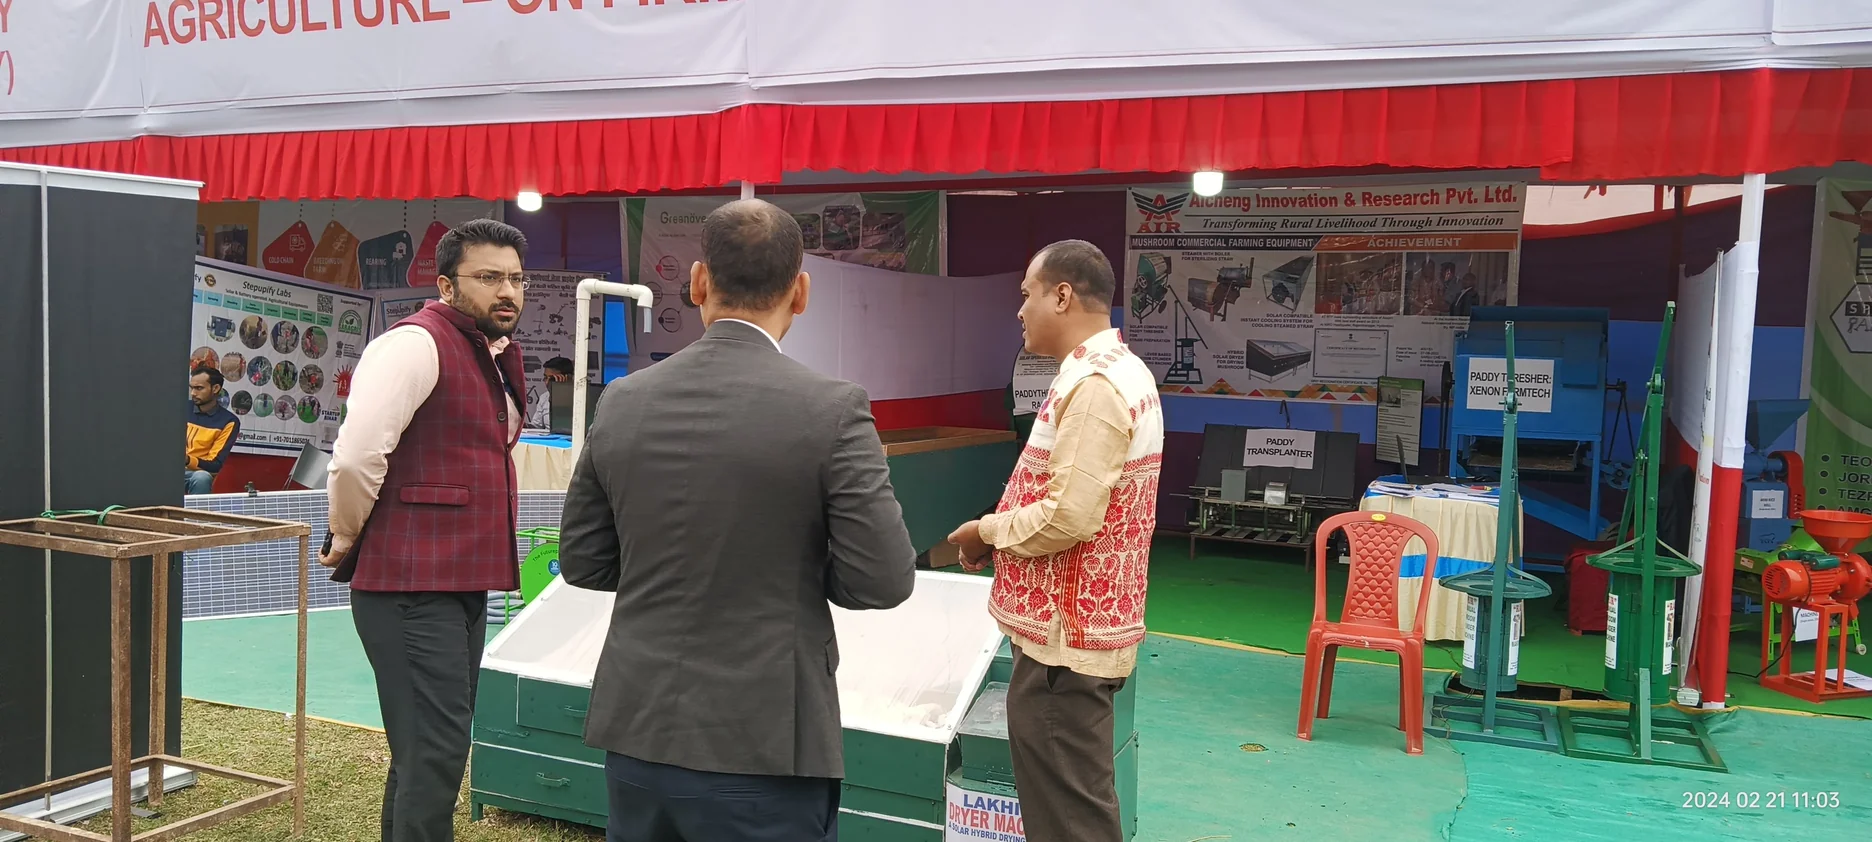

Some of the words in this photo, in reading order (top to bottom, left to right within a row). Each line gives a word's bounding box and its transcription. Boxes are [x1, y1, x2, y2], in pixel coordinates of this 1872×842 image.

[1256, 192, 1338, 208] Innovation
[1344, 192, 1356, 208] &
[1362, 189, 1440, 207] Research
[1446, 187, 1478, 204] Pvt.
[1484, 184, 1517, 203] Ltd.
[1203, 218, 1276, 230] Transforming
[1280, 218, 1312, 229] Rural
[1317, 218, 1378, 229] Livelihood
[1382, 216, 1432, 229] Through
[1436, 216, 1504, 226] Innovation
[1132, 238, 1174, 247] MUSHROOM
[1176, 238, 1226, 247] COMMERCIAL
[1228, 238, 1264, 247] FARMING
[1266, 238, 1313, 248] EQUIPMENT
[1368, 237, 1462, 248] ACHIEVEMENT
[277, 288, 291, 298] Labs
[1470, 372, 1500, 382] PADDY
[1502, 373, 1552, 384] TRESHER:
[1469, 386, 1500, 396] XENON
[1502, 388, 1551, 398] FRMTECH
[1266, 438, 1295, 446] PADDY
[1246, 448, 1312, 458] TRANSPLANTER
[950, 802, 990, 830] DRYER
[952, 824, 969, 835] SOLAR
[971, 829, 997, 840] HYBRID
